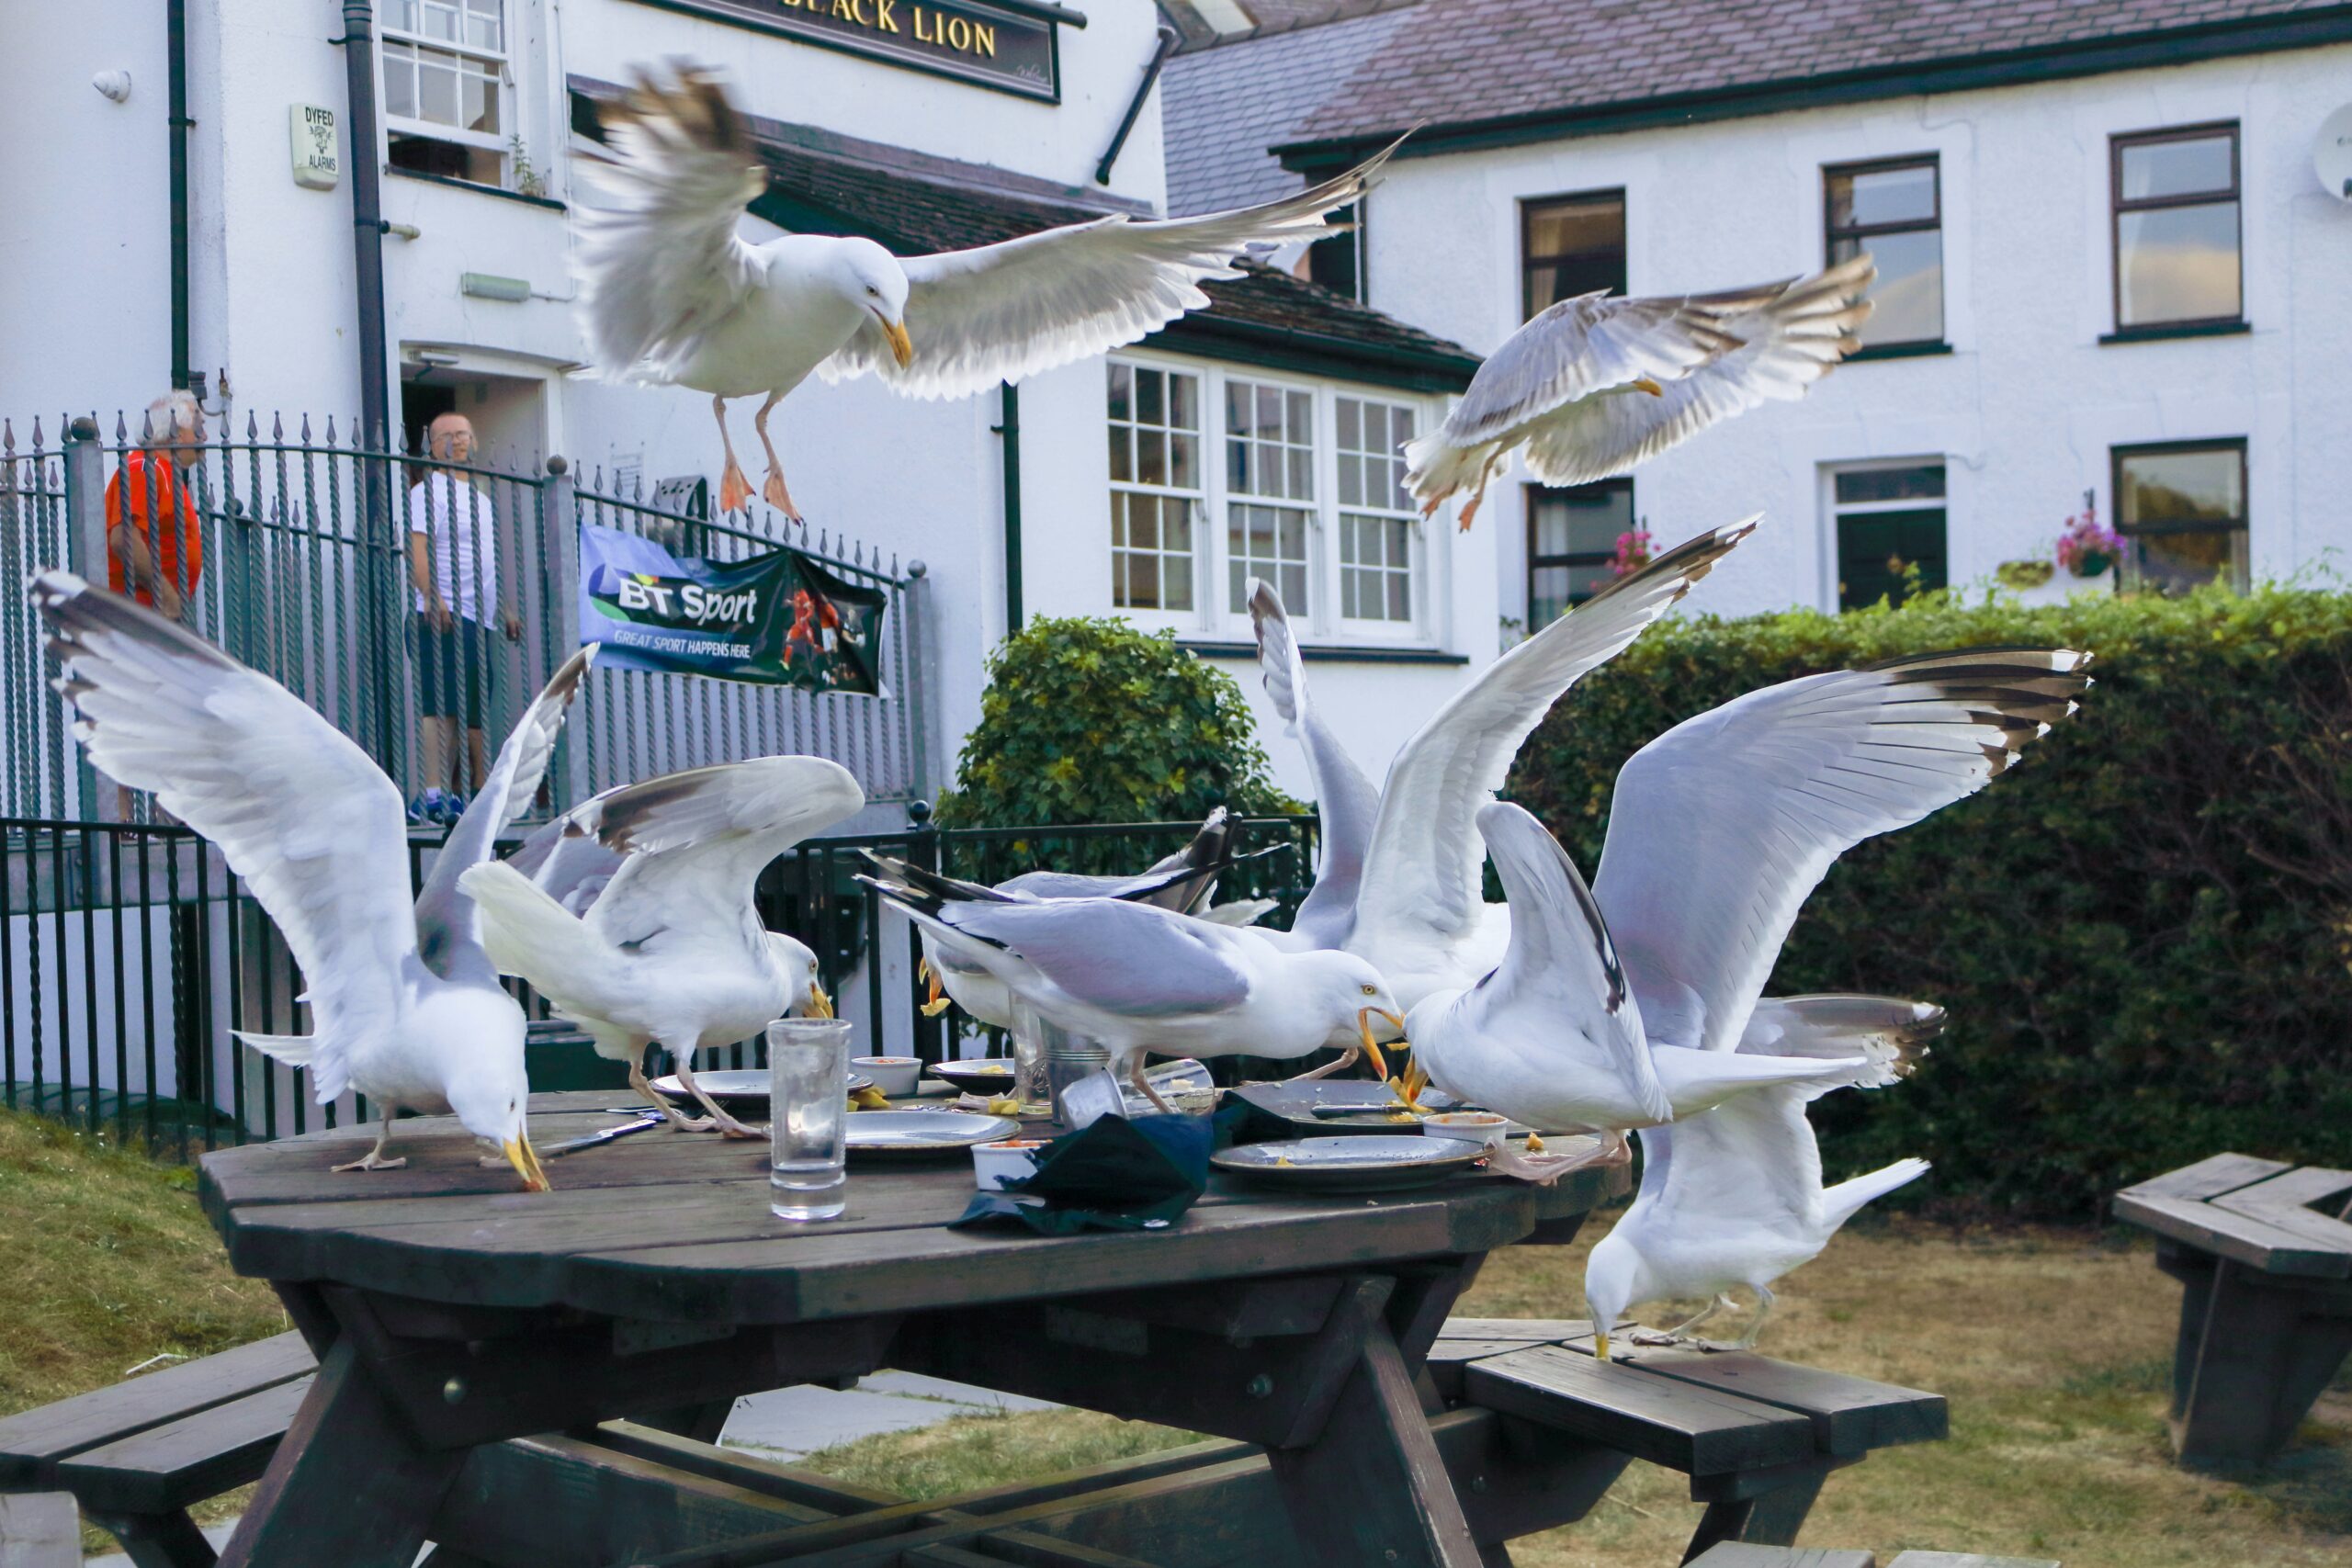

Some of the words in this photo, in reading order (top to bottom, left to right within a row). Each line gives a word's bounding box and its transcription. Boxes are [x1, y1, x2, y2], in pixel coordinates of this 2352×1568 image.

[784, 0, 899, 33] ACK
[914, 6, 995, 57] LION
[305, 107, 334, 127] DYFED
[309, 154, 336, 171] ALARMS
[619, 578, 673, 616] BT
[681, 584, 758, 626] Sport
[614, 629, 653, 647] GREAT
[653, 637, 687, 653] SPORT
[687, 640, 729, 657] HAPPENS
[730, 644, 751, 659] HERE
